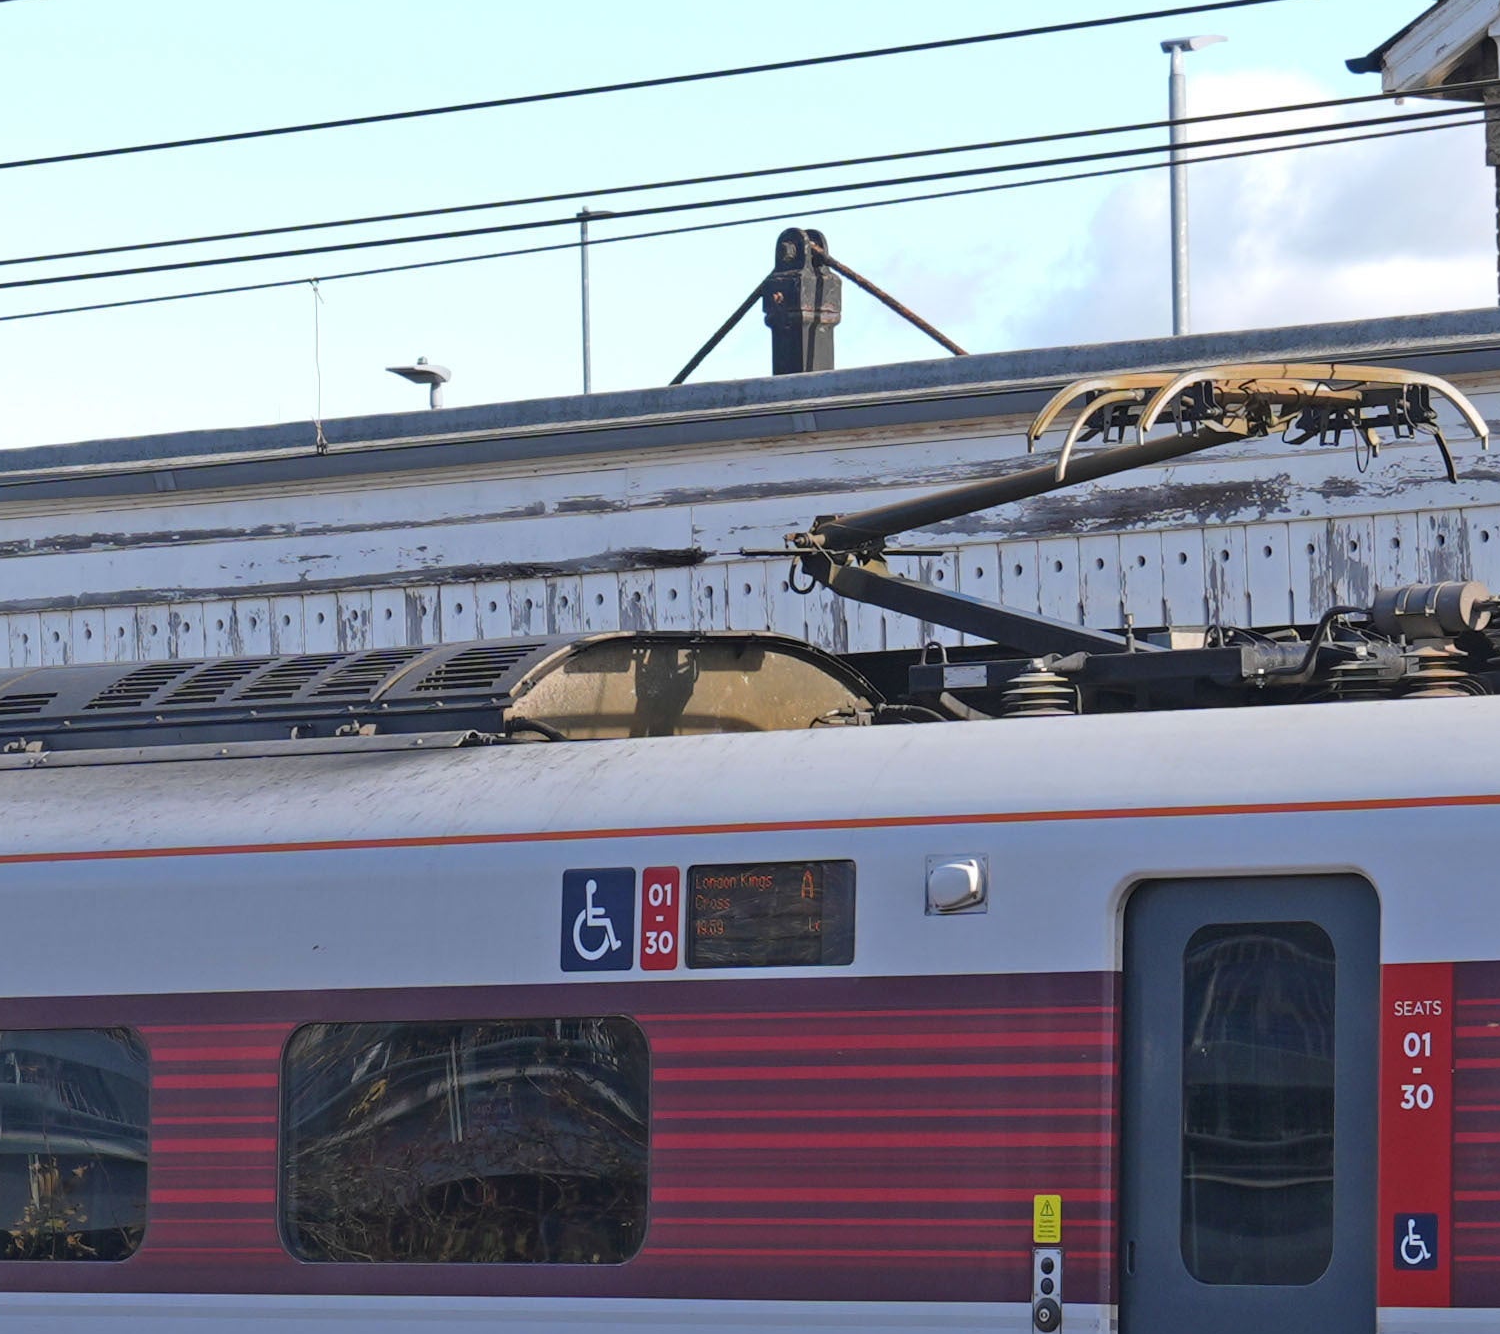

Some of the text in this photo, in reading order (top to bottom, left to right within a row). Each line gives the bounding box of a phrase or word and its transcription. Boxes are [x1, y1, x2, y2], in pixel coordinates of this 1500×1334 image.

[648, 882, 672, 907] 01
[695, 869, 815, 899] London Kings A
[695, 895, 731, 911] Cross
[644, 931, 674, 955] 30
[1393, 1000, 1442, 1016] SEATS
[1403, 1031, 1431, 1058] 01
[1400, 1083, 1434, 1110] 30
